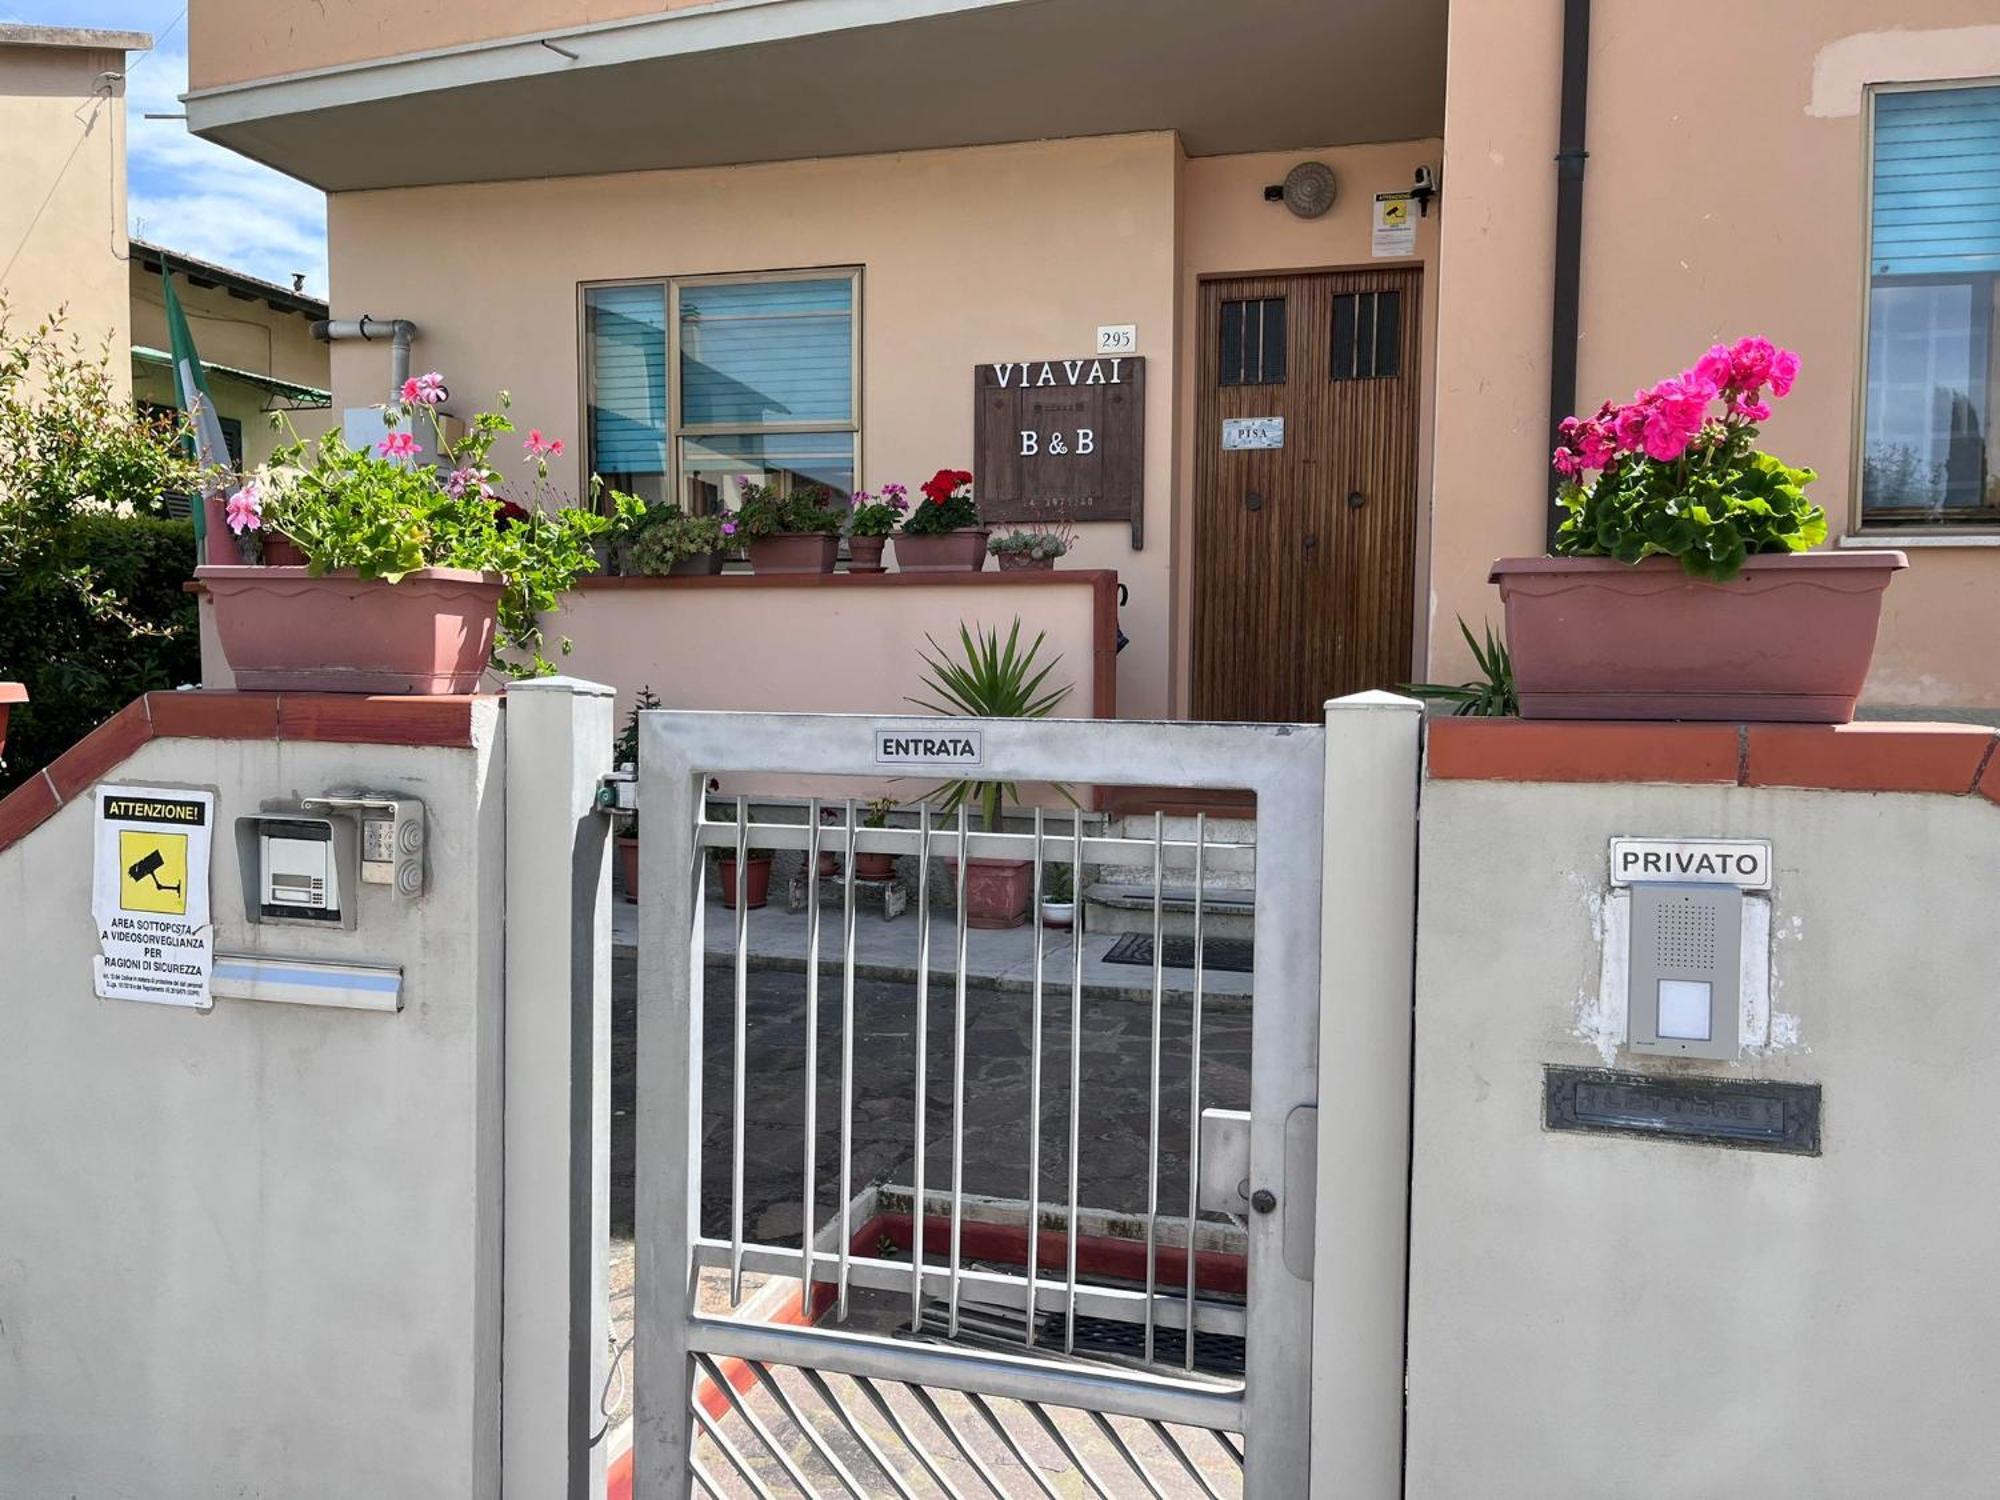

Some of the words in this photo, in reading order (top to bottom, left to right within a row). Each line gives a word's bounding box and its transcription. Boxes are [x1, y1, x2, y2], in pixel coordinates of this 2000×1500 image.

[1102, 331, 1131, 348] 295
[1019, 430, 1039, 456] B
[1048, 431, 1068, 455] &
[1075, 428, 1094, 454] B
[1238, 428, 1267, 439] PISA
[883, 738, 975, 757] ENTRATA
[108, 801, 198, 820] ATTENZIONE!
[1622, 851, 1759, 876] PRIVATO
[111, 918, 135, 929] AREA
[101, 930, 109, 940] A
[111, 931, 205, 949] VIDEOSORVEGLIANZA
[144, 947, 162, 958] PER
[104, 957, 140, 970] RAGIONI
[142, 960, 152, 971] DI
[153, 961, 203, 976] SICUREZZA
[1603, 1089, 1753, 1121] LETTERE
